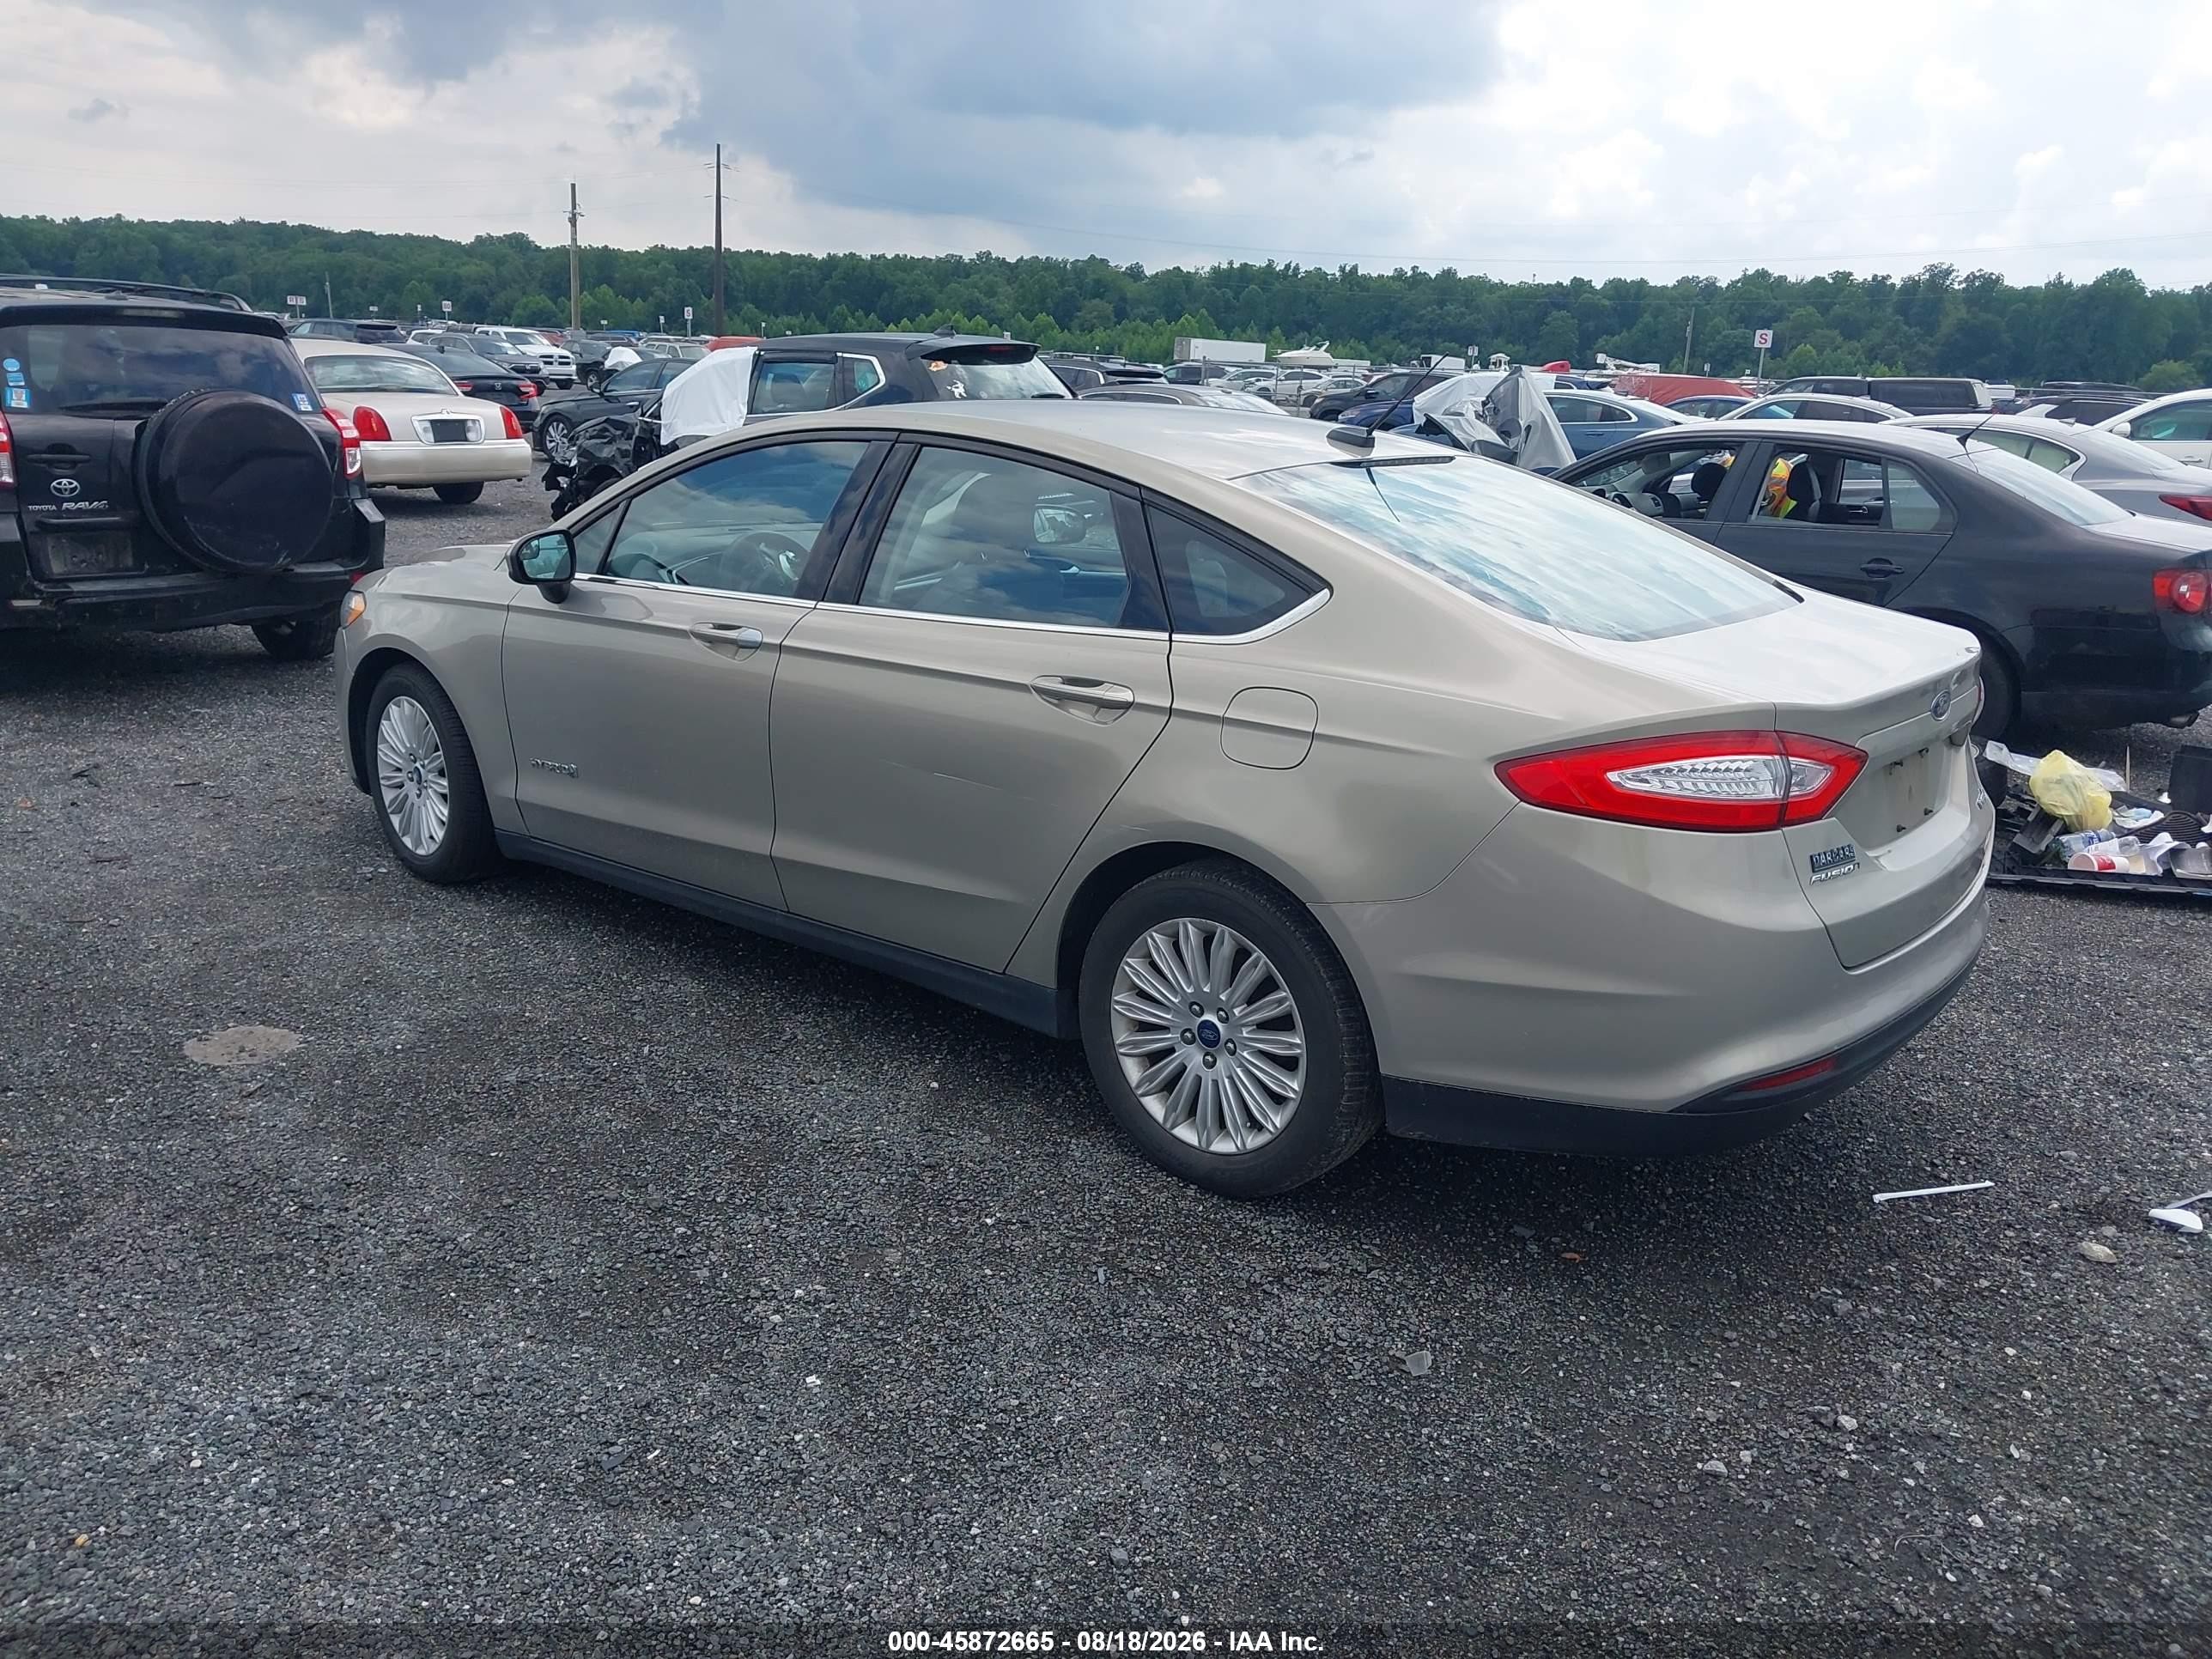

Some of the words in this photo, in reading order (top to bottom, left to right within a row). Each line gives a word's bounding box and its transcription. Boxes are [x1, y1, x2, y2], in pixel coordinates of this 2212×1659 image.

[1758, 332, 1769, 345] S
[61, 501, 109, 510] RAV4
[1809, 862, 1860, 885] FUSION
